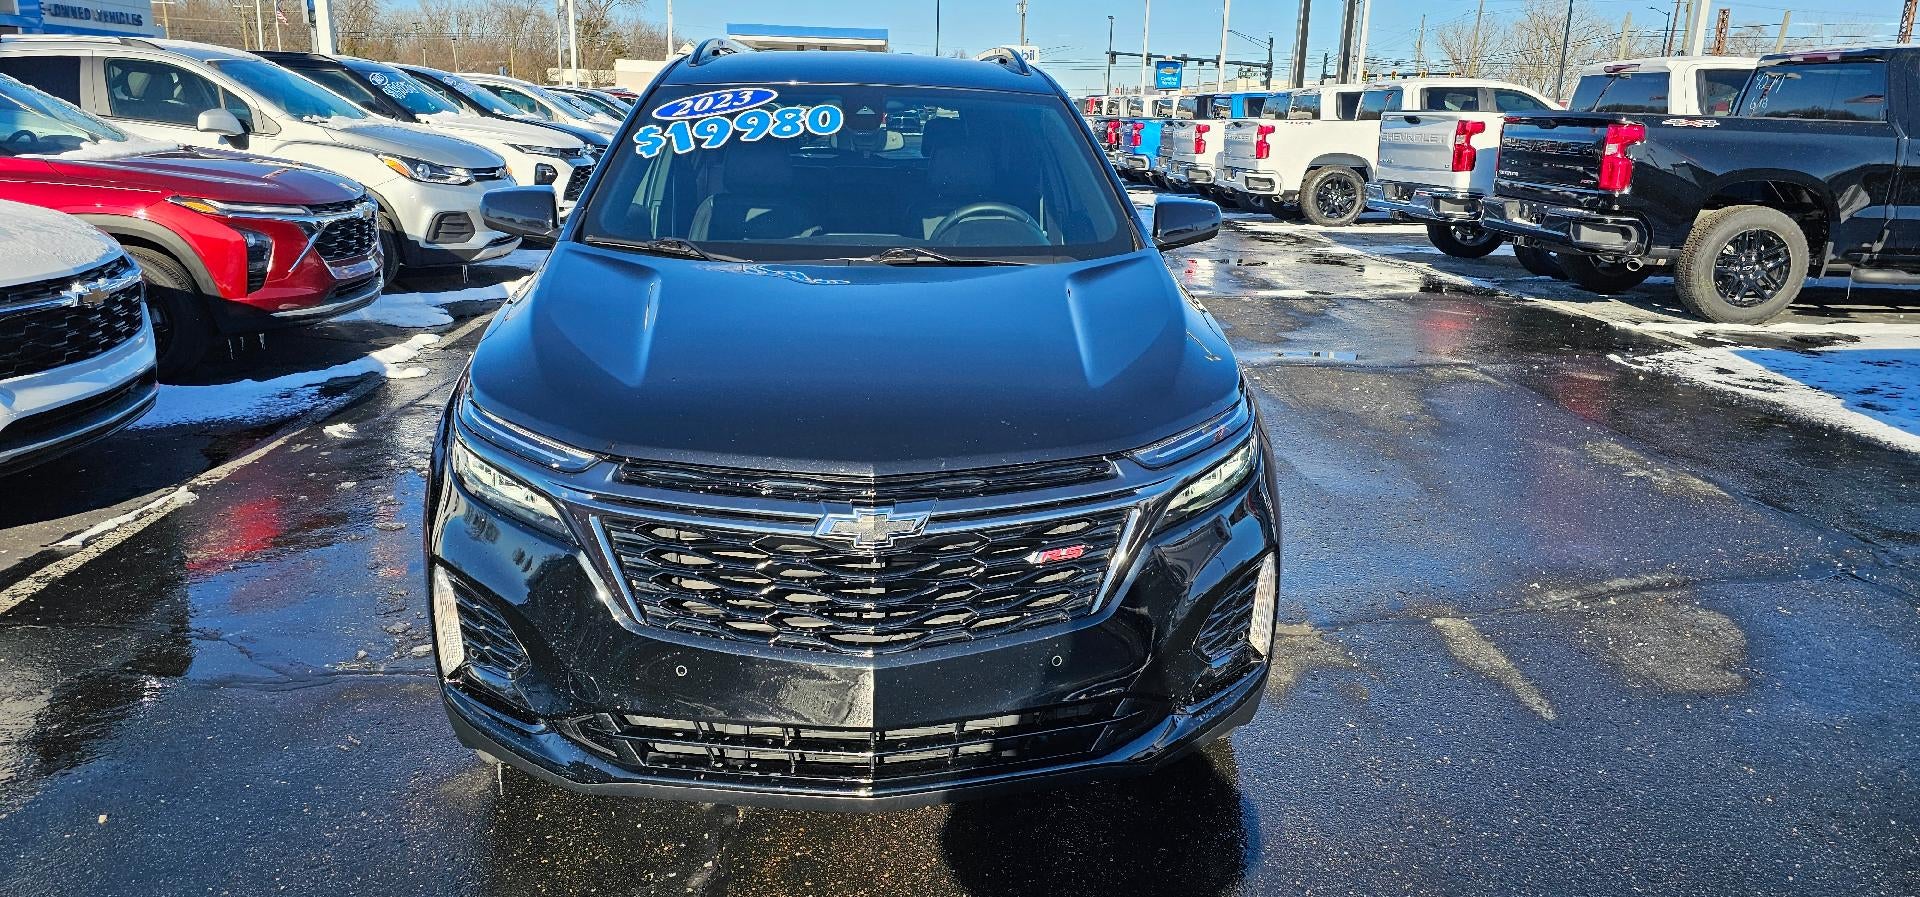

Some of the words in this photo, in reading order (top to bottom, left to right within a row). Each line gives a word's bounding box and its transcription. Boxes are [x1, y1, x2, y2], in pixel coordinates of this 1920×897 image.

[95, 9, 143, 26] VEHICLES
[671, 90, 754, 117] 2023
[633, 104, 844, 158] $19980
[1380, 132, 1447, 144] CHEVROLET
[1039, 544, 1086, 566] RS
